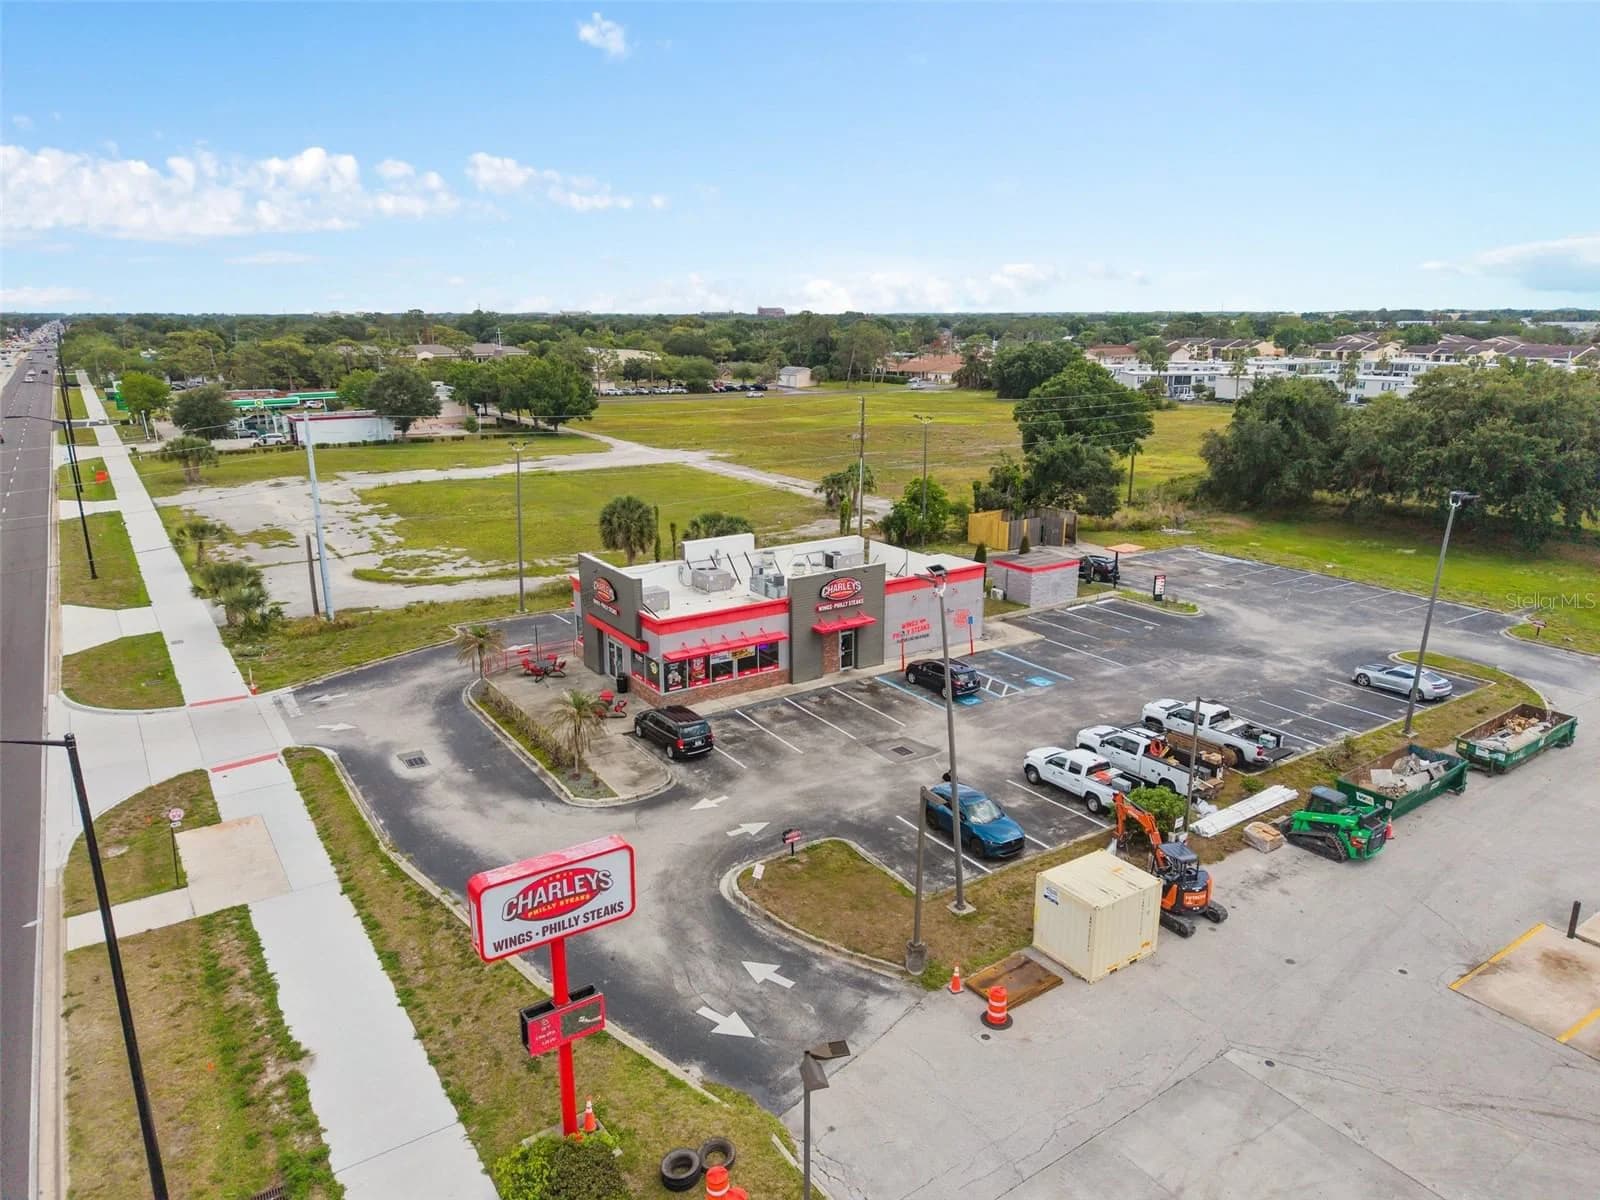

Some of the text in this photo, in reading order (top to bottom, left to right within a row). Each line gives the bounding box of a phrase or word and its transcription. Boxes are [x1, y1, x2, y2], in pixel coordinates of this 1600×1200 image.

[821, 580, 862, 598] CHARLEYS
[502, 869, 613, 921] CHARLEYS
[528, 902, 557, 918] PHILLY
[493, 901, 624, 952] WINGS PHILLY STEAKS
